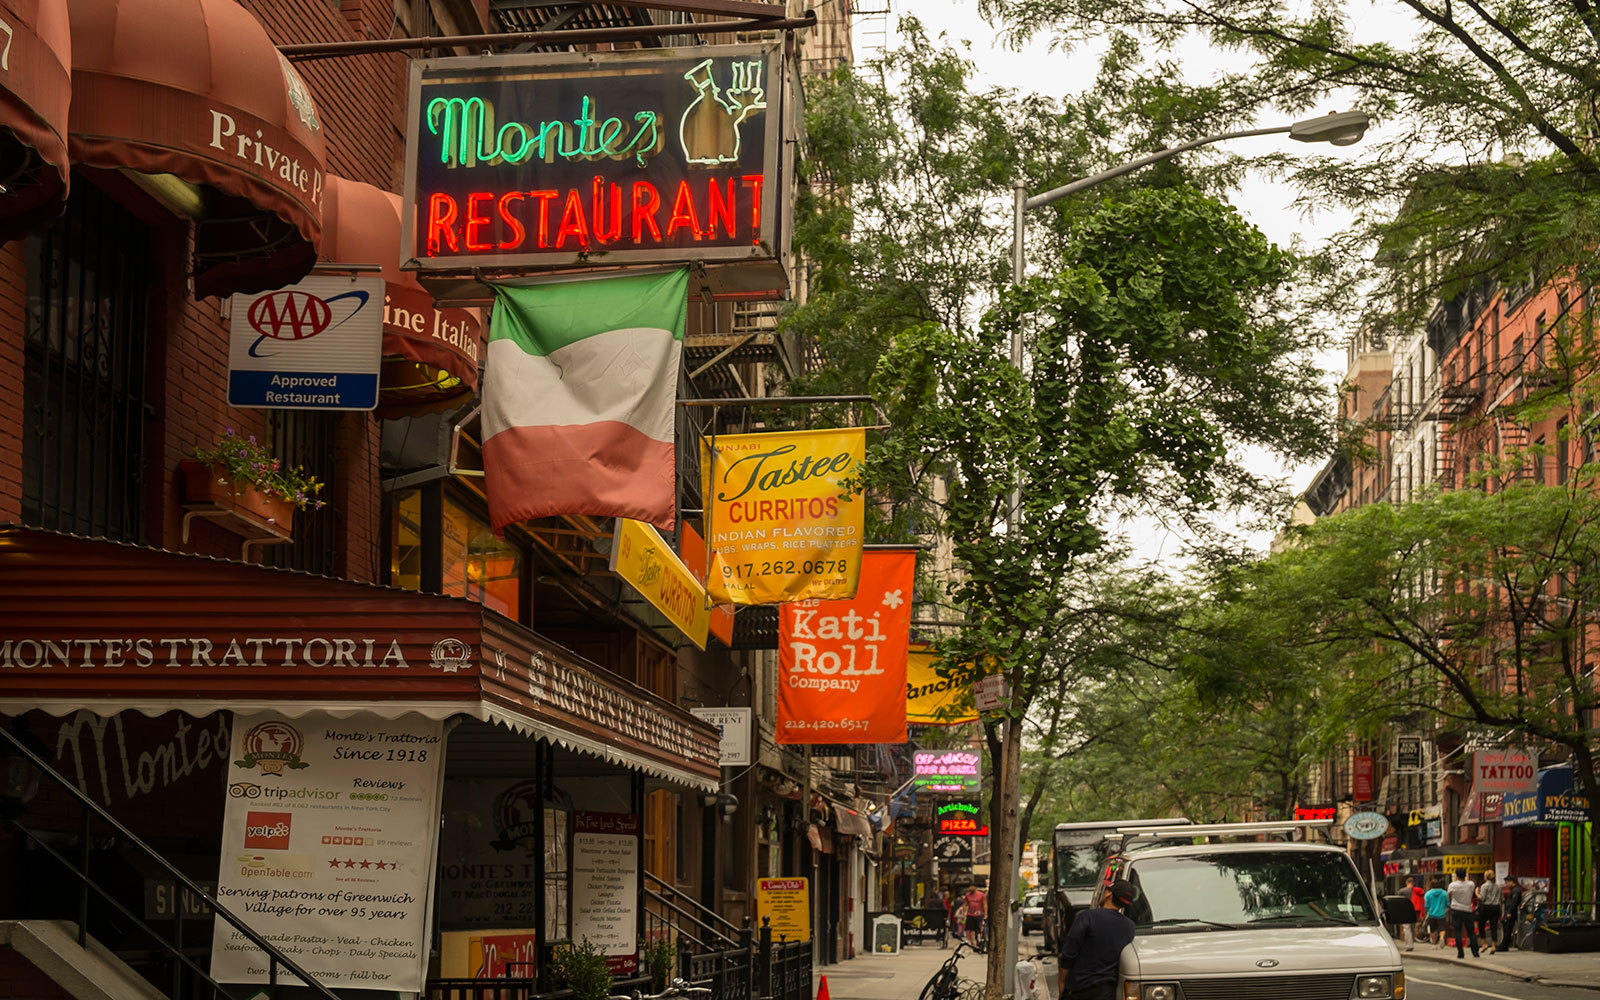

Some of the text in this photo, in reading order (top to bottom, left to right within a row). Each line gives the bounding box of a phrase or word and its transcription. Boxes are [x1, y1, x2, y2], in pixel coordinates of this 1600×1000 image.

[427, 95, 662, 168] Montes
[209, 109, 308, 193] Private
[427, 174, 764, 257] RESTAURANT
[255, 291, 326, 340] AAA
[383, 294, 478, 362] ine Italian
[270, 373, 337, 389] Approved
[265, 390, 341, 405] Restaurant
[714, 443, 761, 452] UNJABI
[718, 444, 852, 502] Tastee
[729, 496, 839, 524] CURRITOS
[713, 526, 857, 543] INDIAN FLAVORED
[782, 540, 806, 549] RICE
[809, 537, 858, 549] PLATTERS
[723, 559, 848, 579] 917.262.0678
[723, 583, 756, 591] HALAL
[660, 566, 697, 628] CURRITOS
[791, 608, 887, 642] Kati
[160, 637, 410, 668] TRATTORIA
[789, 642, 885, 676] Roll
[789, 675, 861, 693] Company
[784, 718, 870, 732] 212.420.6517
[324, 730, 441, 744] Monte's Trattoria
[333, 746, 428, 762] Since 1918
[1480, 765, 1534, 779] TATTOO
[352, 777, 406, 790] Reviews
[263, 786, 341, 800] tripadvisor
[1544, 794, 1569, 808] NYC
[1503, 798, 1522, 818] NYC
[1521, 796, 1538, 815] INK
[941, 819, 977, 831] PIZZA
[218, 886, 416, 904] Serving patrons of Greenwich
[244, 902, 408, 920] Village for over 95 years
[293, 934, 328, 945] Pastas
[336, 935, 362, 945] Veal
[369, 938, 414, 948] Chicken
[275, 944, 305, 955] teaks
[311, 946, 341, 957] Chops
[349, 948, 376, 959] Daily
[378, 950, 417, 960] Specials
[247, 966, 266, 976] two
[349, 970, 371, 982] full
[371, 971, 392, 981] bar
